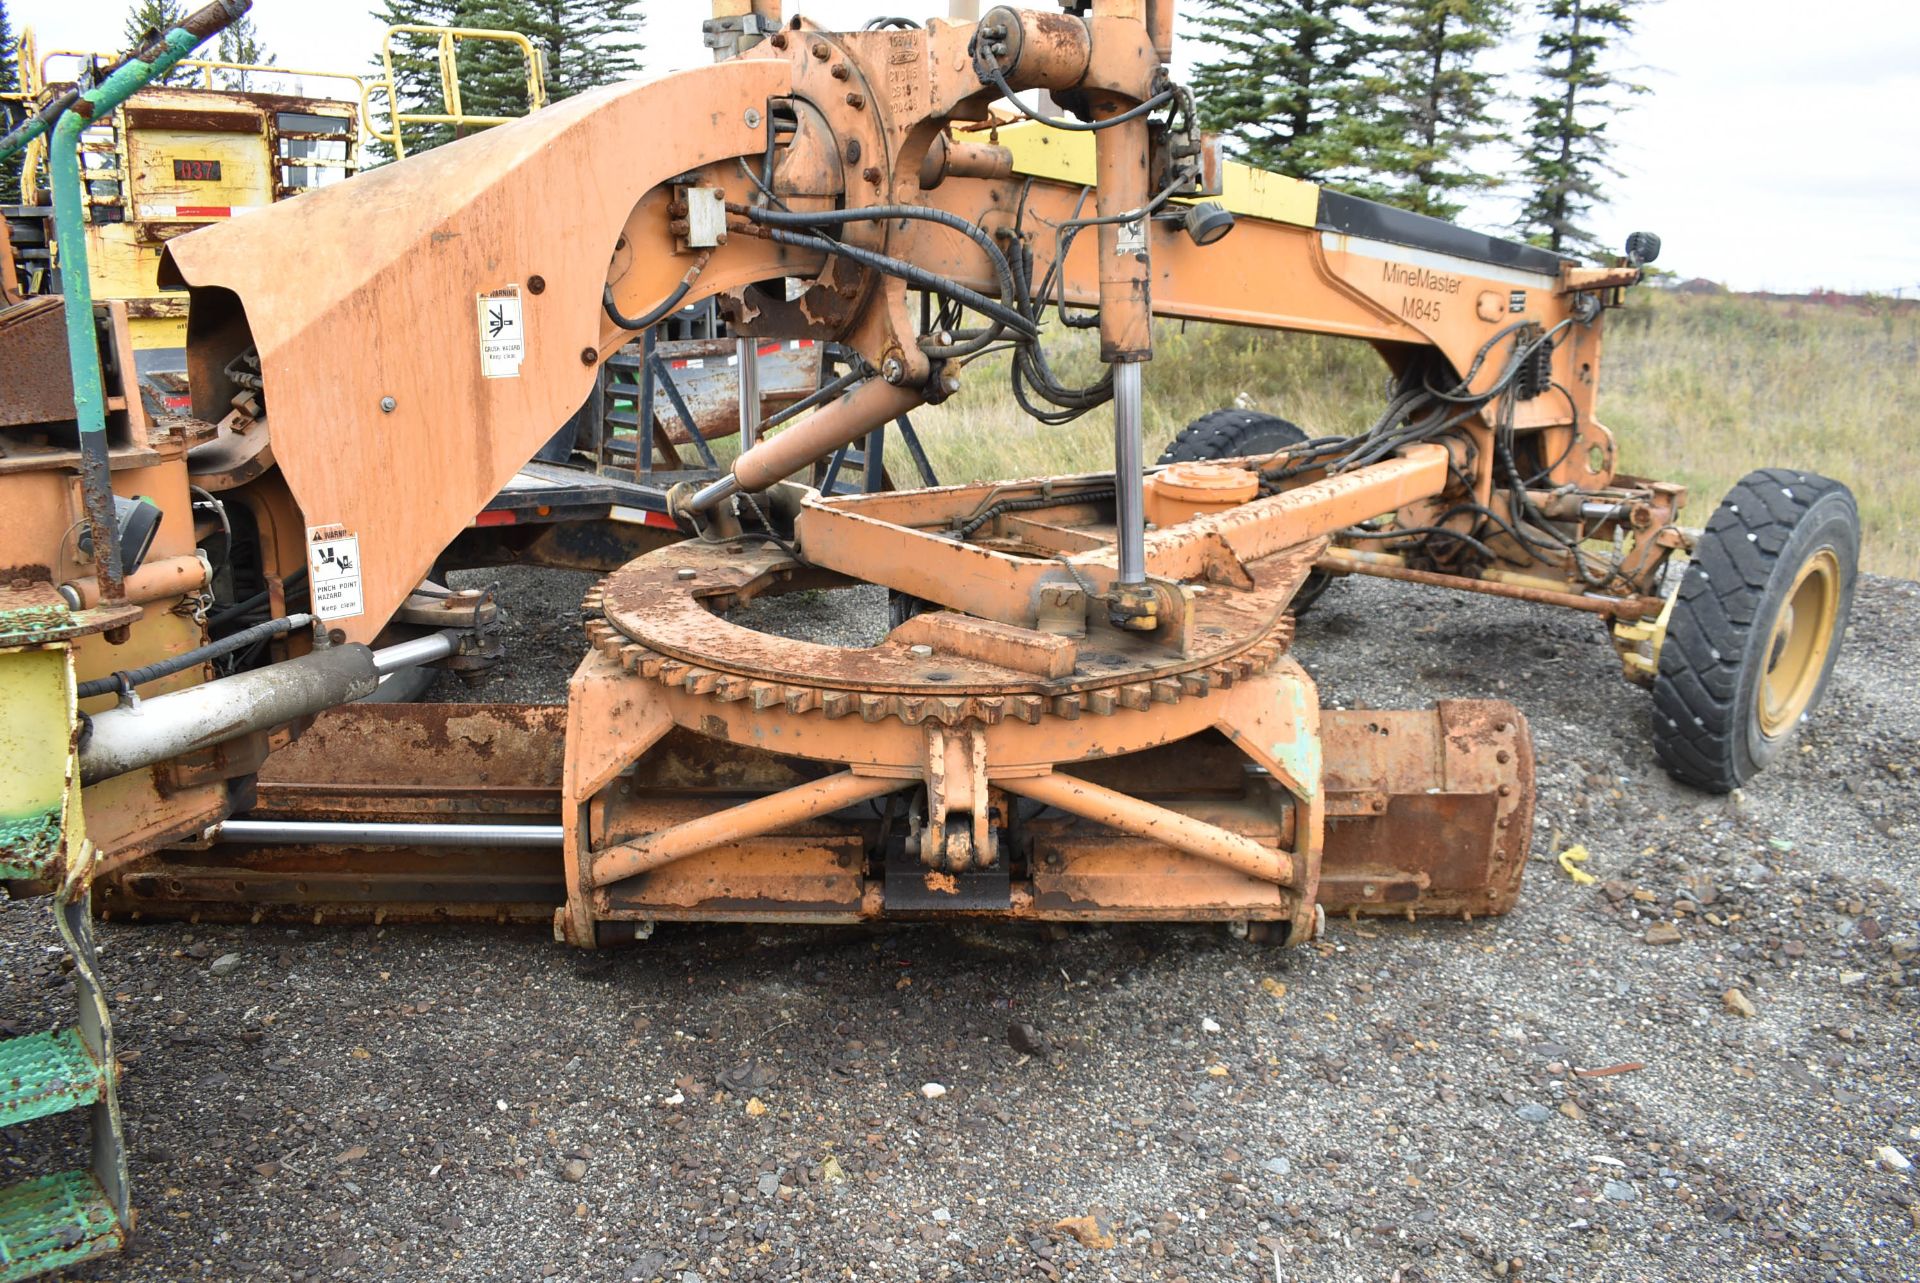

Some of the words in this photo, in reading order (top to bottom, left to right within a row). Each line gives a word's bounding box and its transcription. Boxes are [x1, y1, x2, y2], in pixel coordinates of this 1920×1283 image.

[1382, 261, 1463, 295] MineMaster
[1401, 296, 1441, 323] M845
[317, 585, 336, 594] PINCH
[339, 581, 358, 590] POINT
[317, 592, 342, 601] HAZARD
[322, 604, 338, 612] Keep
